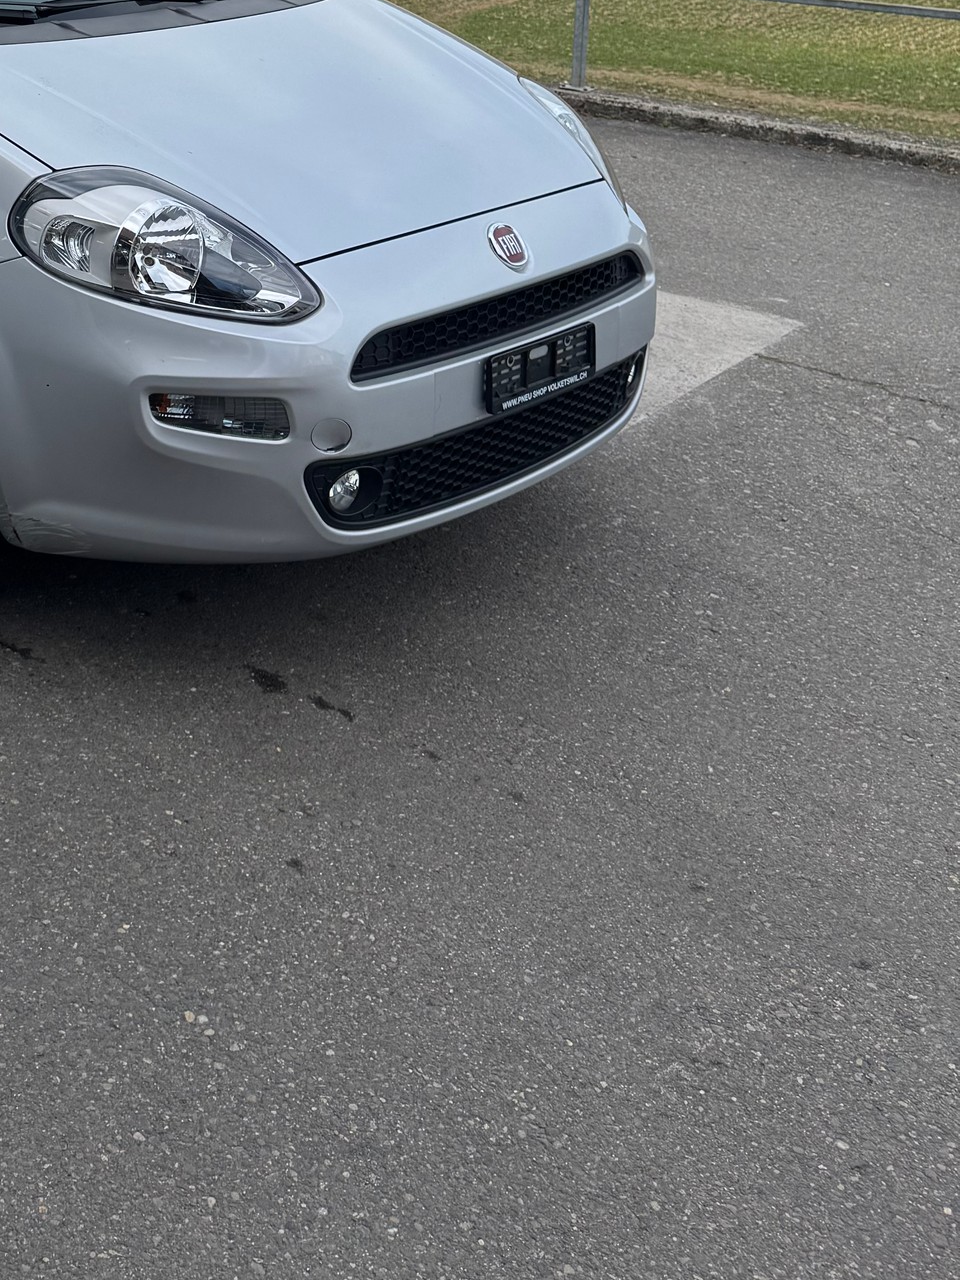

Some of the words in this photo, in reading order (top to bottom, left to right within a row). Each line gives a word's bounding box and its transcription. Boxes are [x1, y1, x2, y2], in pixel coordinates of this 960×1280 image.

[497, 233, 522, 257] FIAT
[502, 392, 533, 411] WWW.PNEU
[533, 386, 548, 399] SHOP
[548, 370, 588, 393] VOLKETSWIL.CH
